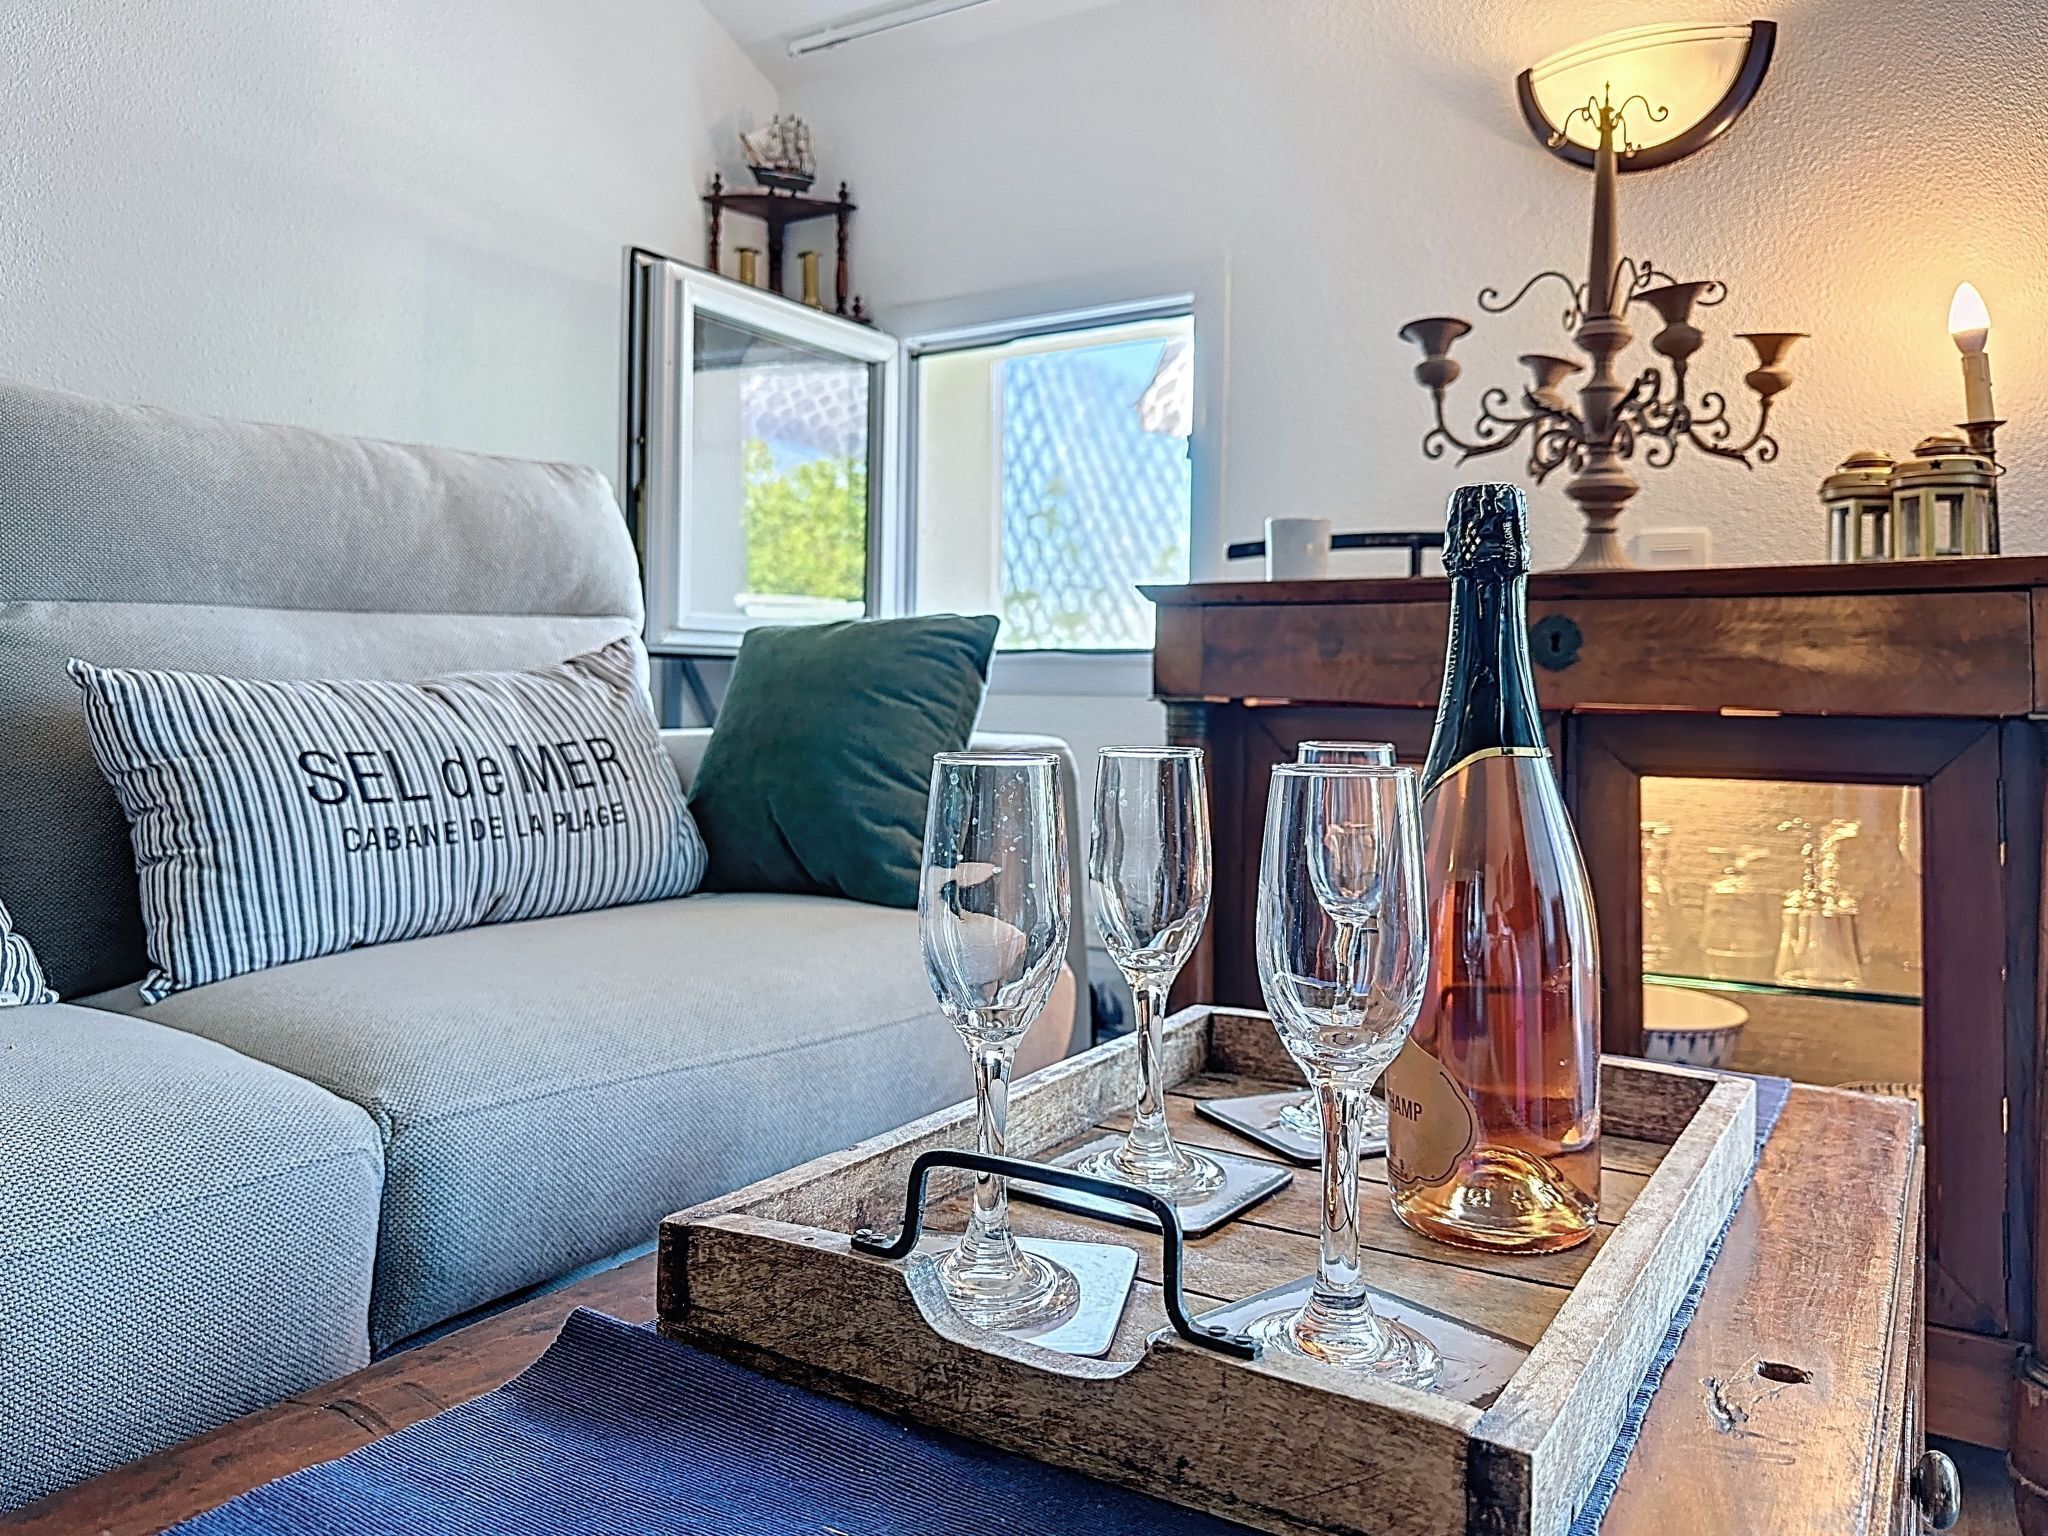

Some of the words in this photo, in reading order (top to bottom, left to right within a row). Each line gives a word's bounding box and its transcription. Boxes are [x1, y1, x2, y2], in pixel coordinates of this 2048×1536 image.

[1503, 521, 1517, 568] CHAMPAGNE
[299, 750, 433, 805] SEL
[442, 746, 504, 798] de
[509, 738, 630, 793] MER
[344, 820, 459, 853] CABANE
[471, 816, 504, 841] DE
[515, 814, 545, 838] LA
[553, 801, 626, 833] PLAGE
